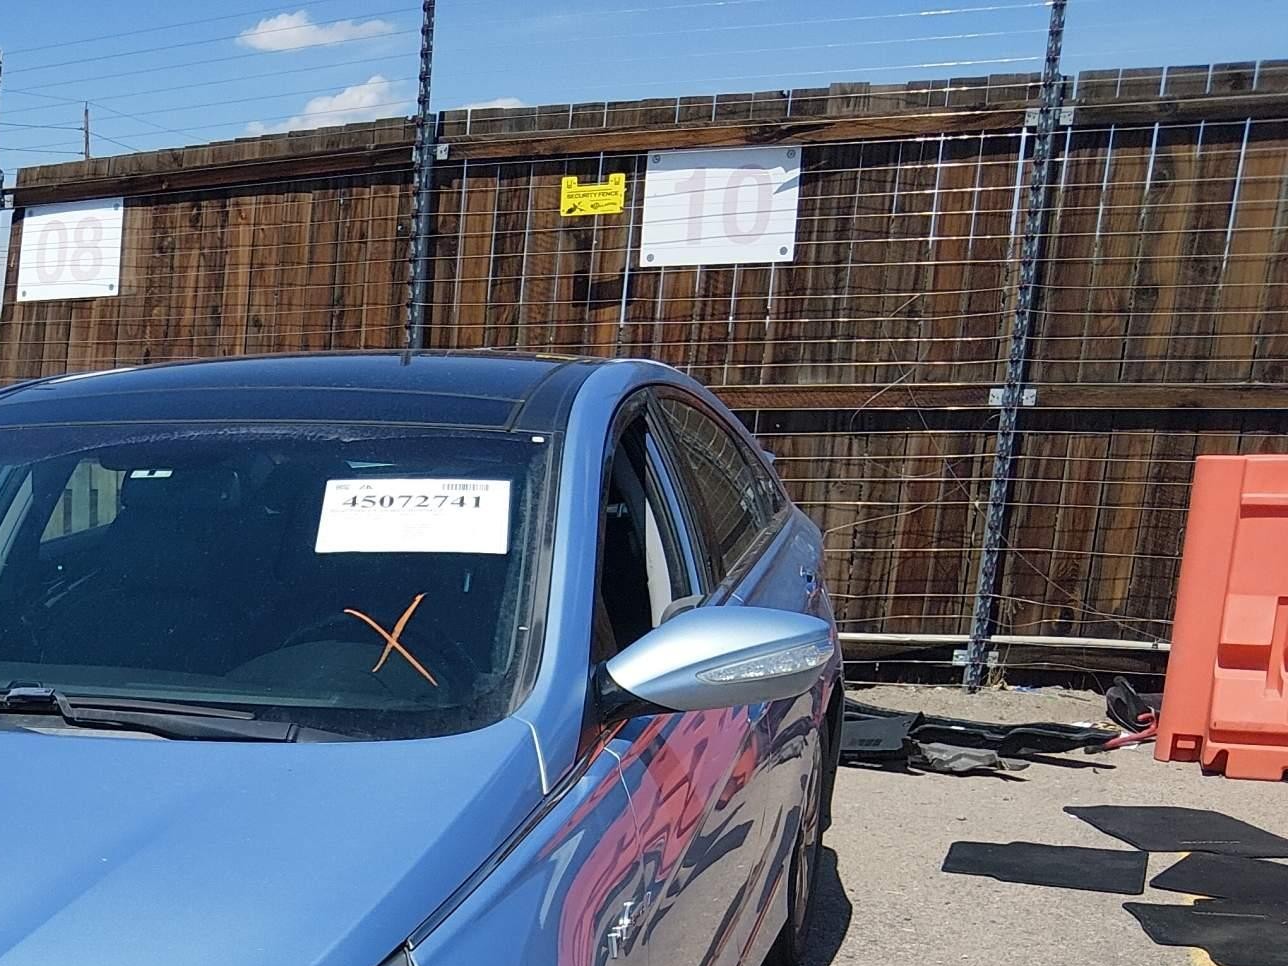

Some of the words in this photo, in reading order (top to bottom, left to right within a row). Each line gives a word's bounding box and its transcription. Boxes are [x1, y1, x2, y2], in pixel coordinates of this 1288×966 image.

[598, 190, 618, 198] FENCE
[674, 164, 773, 245] 10
[37, 217, 103, 283] 08
[342, 494, 482, 509] 45072741
